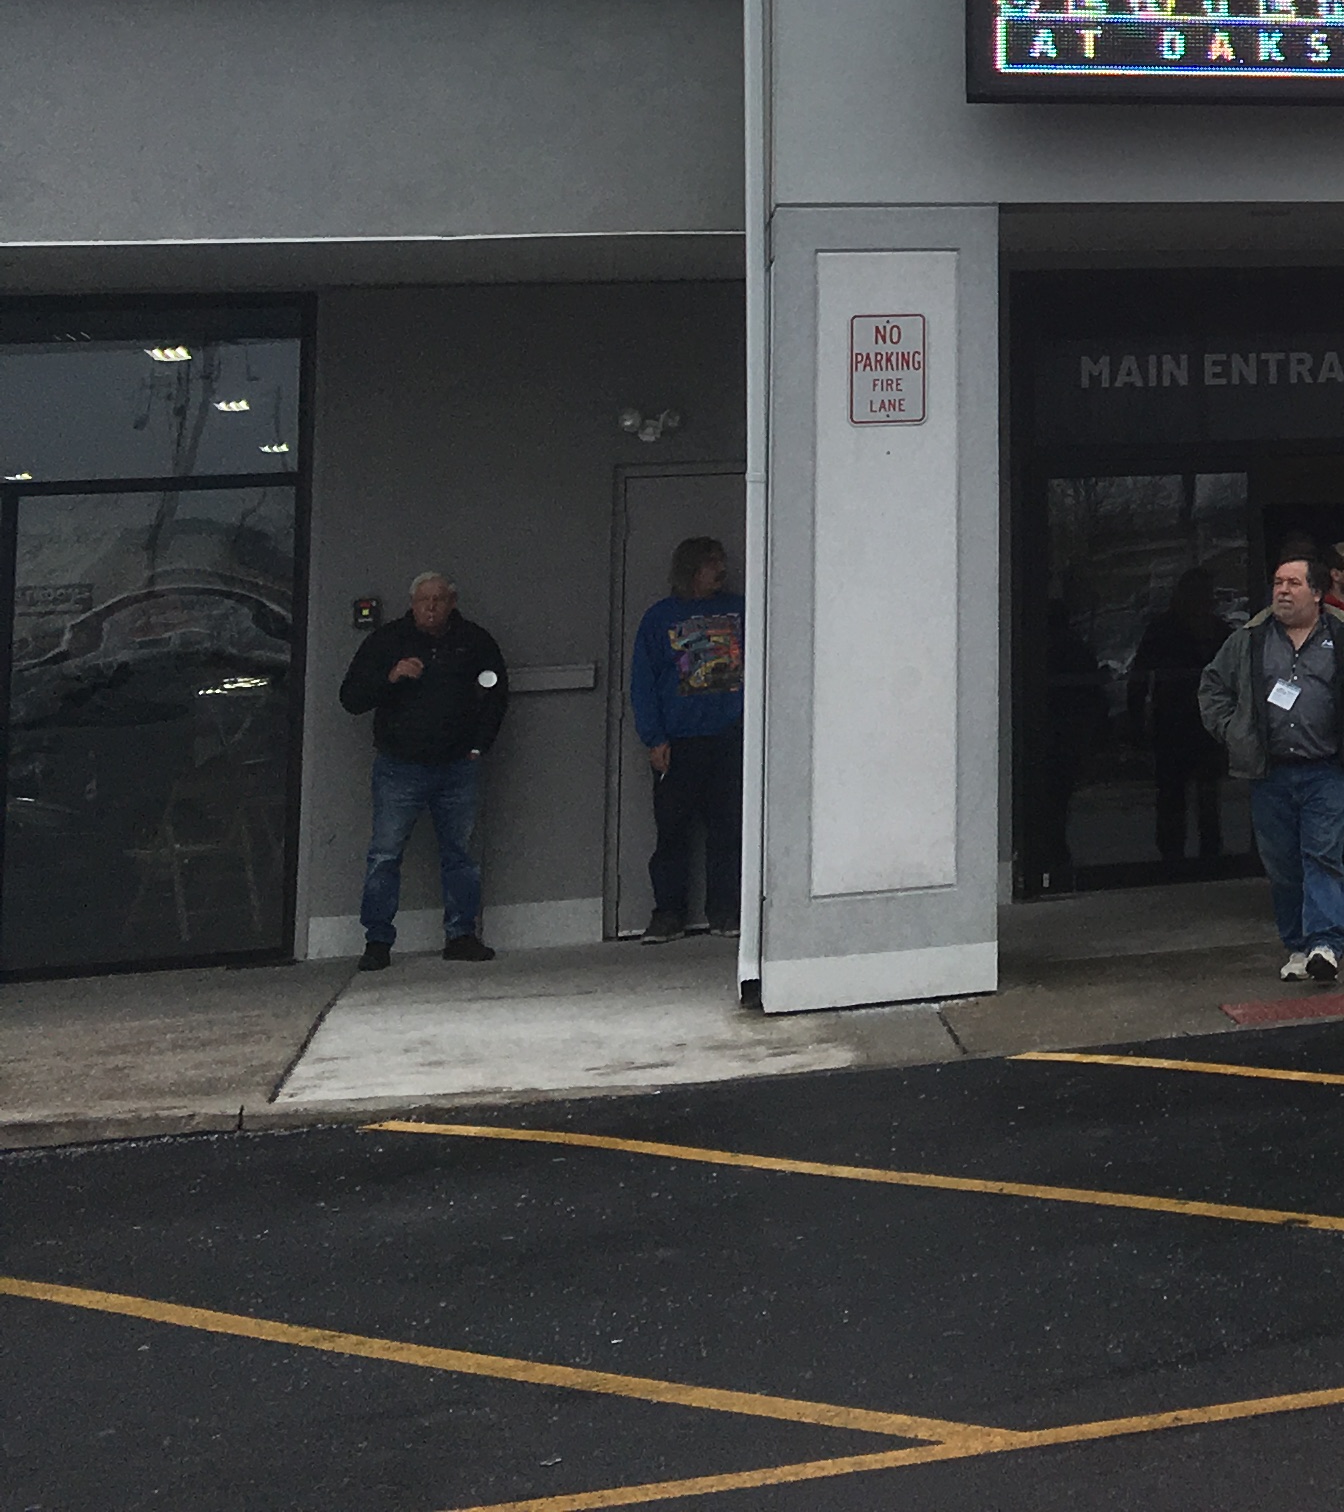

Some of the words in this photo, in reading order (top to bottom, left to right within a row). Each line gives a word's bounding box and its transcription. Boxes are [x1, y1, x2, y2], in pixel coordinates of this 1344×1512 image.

[1029, 29, 1103, 59] AT
[1159, 31, 1332, 63] OAKS
[874, 324, 902, 345] NO
[855, 350, 922, 372] PARKING
[1080, 354, 1189, 388] MAIN
[872, 377, 904, 392] FIRE
[869, 398, 906, 413] LANE
